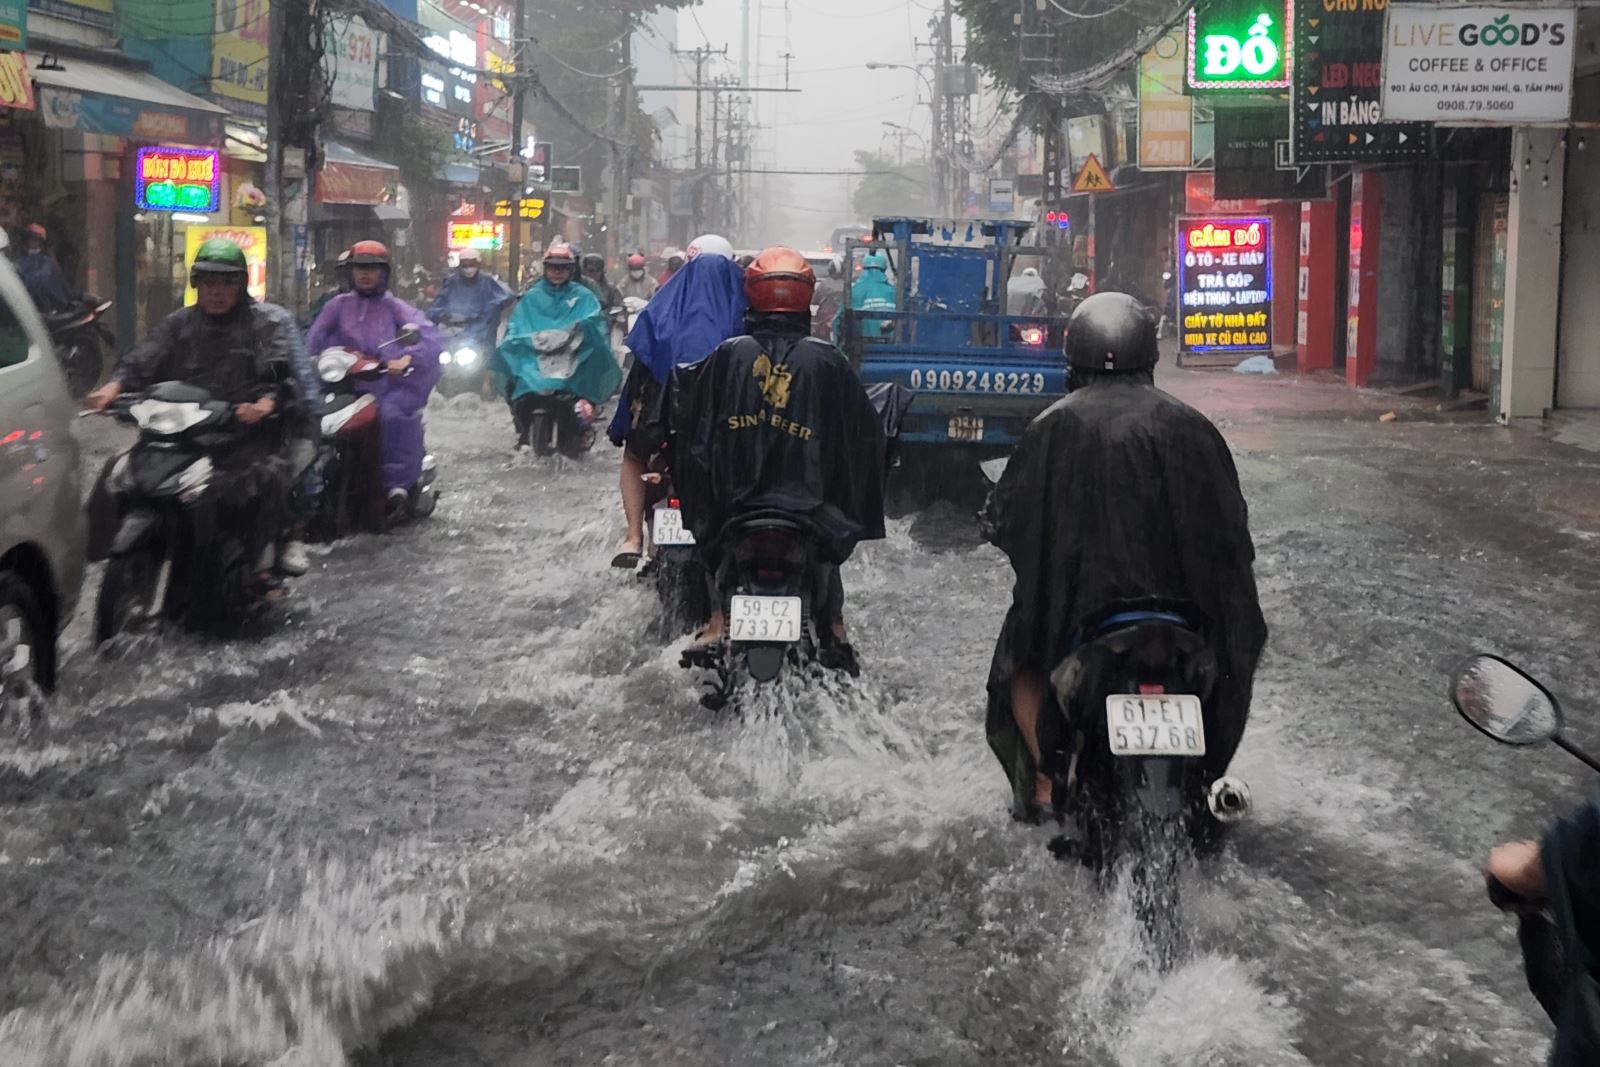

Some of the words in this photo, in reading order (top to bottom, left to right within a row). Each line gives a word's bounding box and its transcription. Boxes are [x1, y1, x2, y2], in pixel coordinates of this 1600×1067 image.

[1393, 23, 1454, 46] LIVE
[1458, 22, 1565, 46] GOOD'S
[1204, 13, 1278, 75] ĐỒ
[1409, 57, 1469, 72] COFFEE
[1474, 57, 1484, 72] &
[1490, 57, 1548, 72] OFFICE
[1322, 63, 1348, 88] LED
[1391, 84, 1406, 93] 901
[1451, 82, 1468, 92] TÂN
[1525, 82, 1543, 93] TÂN
[1544, 82, 1564, 93] PHÚ
[1322, 101, 1336, 125] IN
[1340, 95, 1380, 125] BĂNG
[1185, 251, 1195, 267] Ô
[1196, 250, 1214, 267] TÔ
[1222, 252, 1237, 266] XE
[1239, 249, 1264, 265] MÁY
[1197, 270, 1224, 288] TRẢ
[1226, 271, 1254, 287] GÓP
[1236, 290, 1267, 304] LAPTOP
[1185, 312, 1208, 328] GIẤY
[1184, 333, 1204, 345] MUA
[1205, 333, 1217, 345] XE
[1249, 332, 1267, 344] CAO
[910, 369, 1044, 393] 0909248229
[770, 414, 812, 440] BEER
